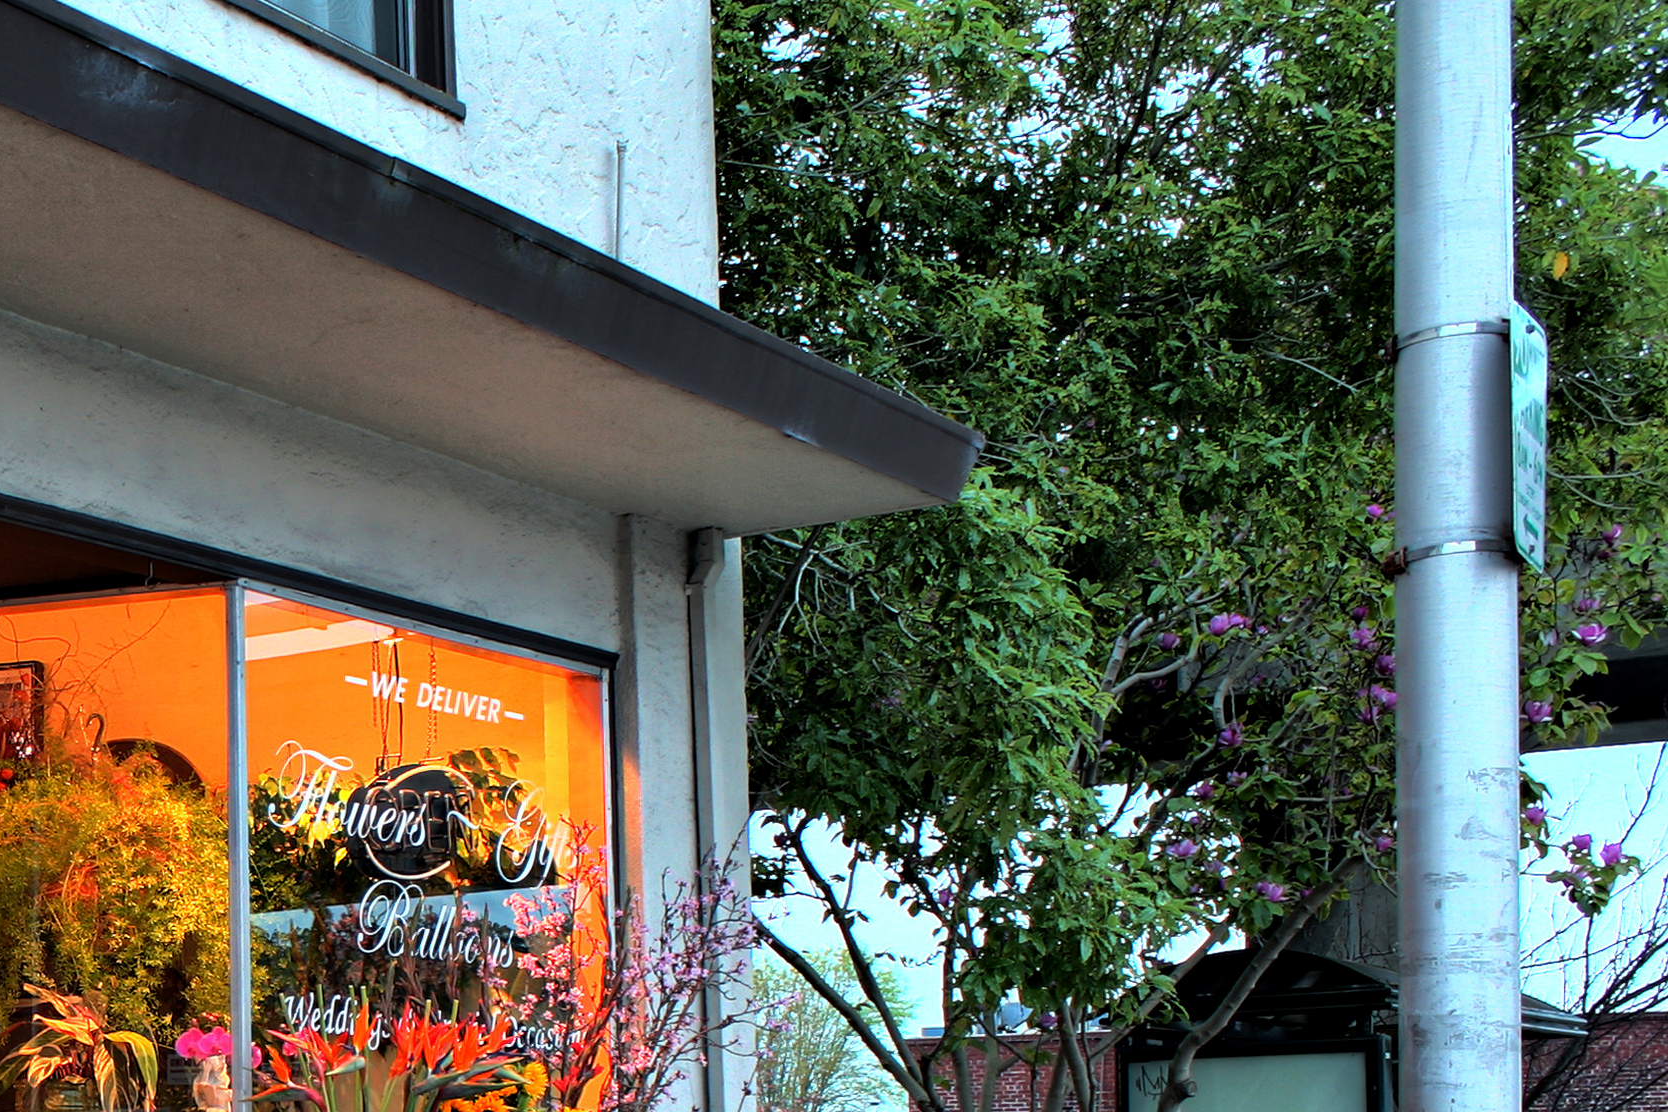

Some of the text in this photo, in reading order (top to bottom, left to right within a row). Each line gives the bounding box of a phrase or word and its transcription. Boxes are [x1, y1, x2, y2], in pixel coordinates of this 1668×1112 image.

[370, 671, 501, 724] WE DELIVER
[268, 740, 426, 847] Flowers
[364, 786, 476, 852] OPEN
[357, 879, 514, 968] Balloons
